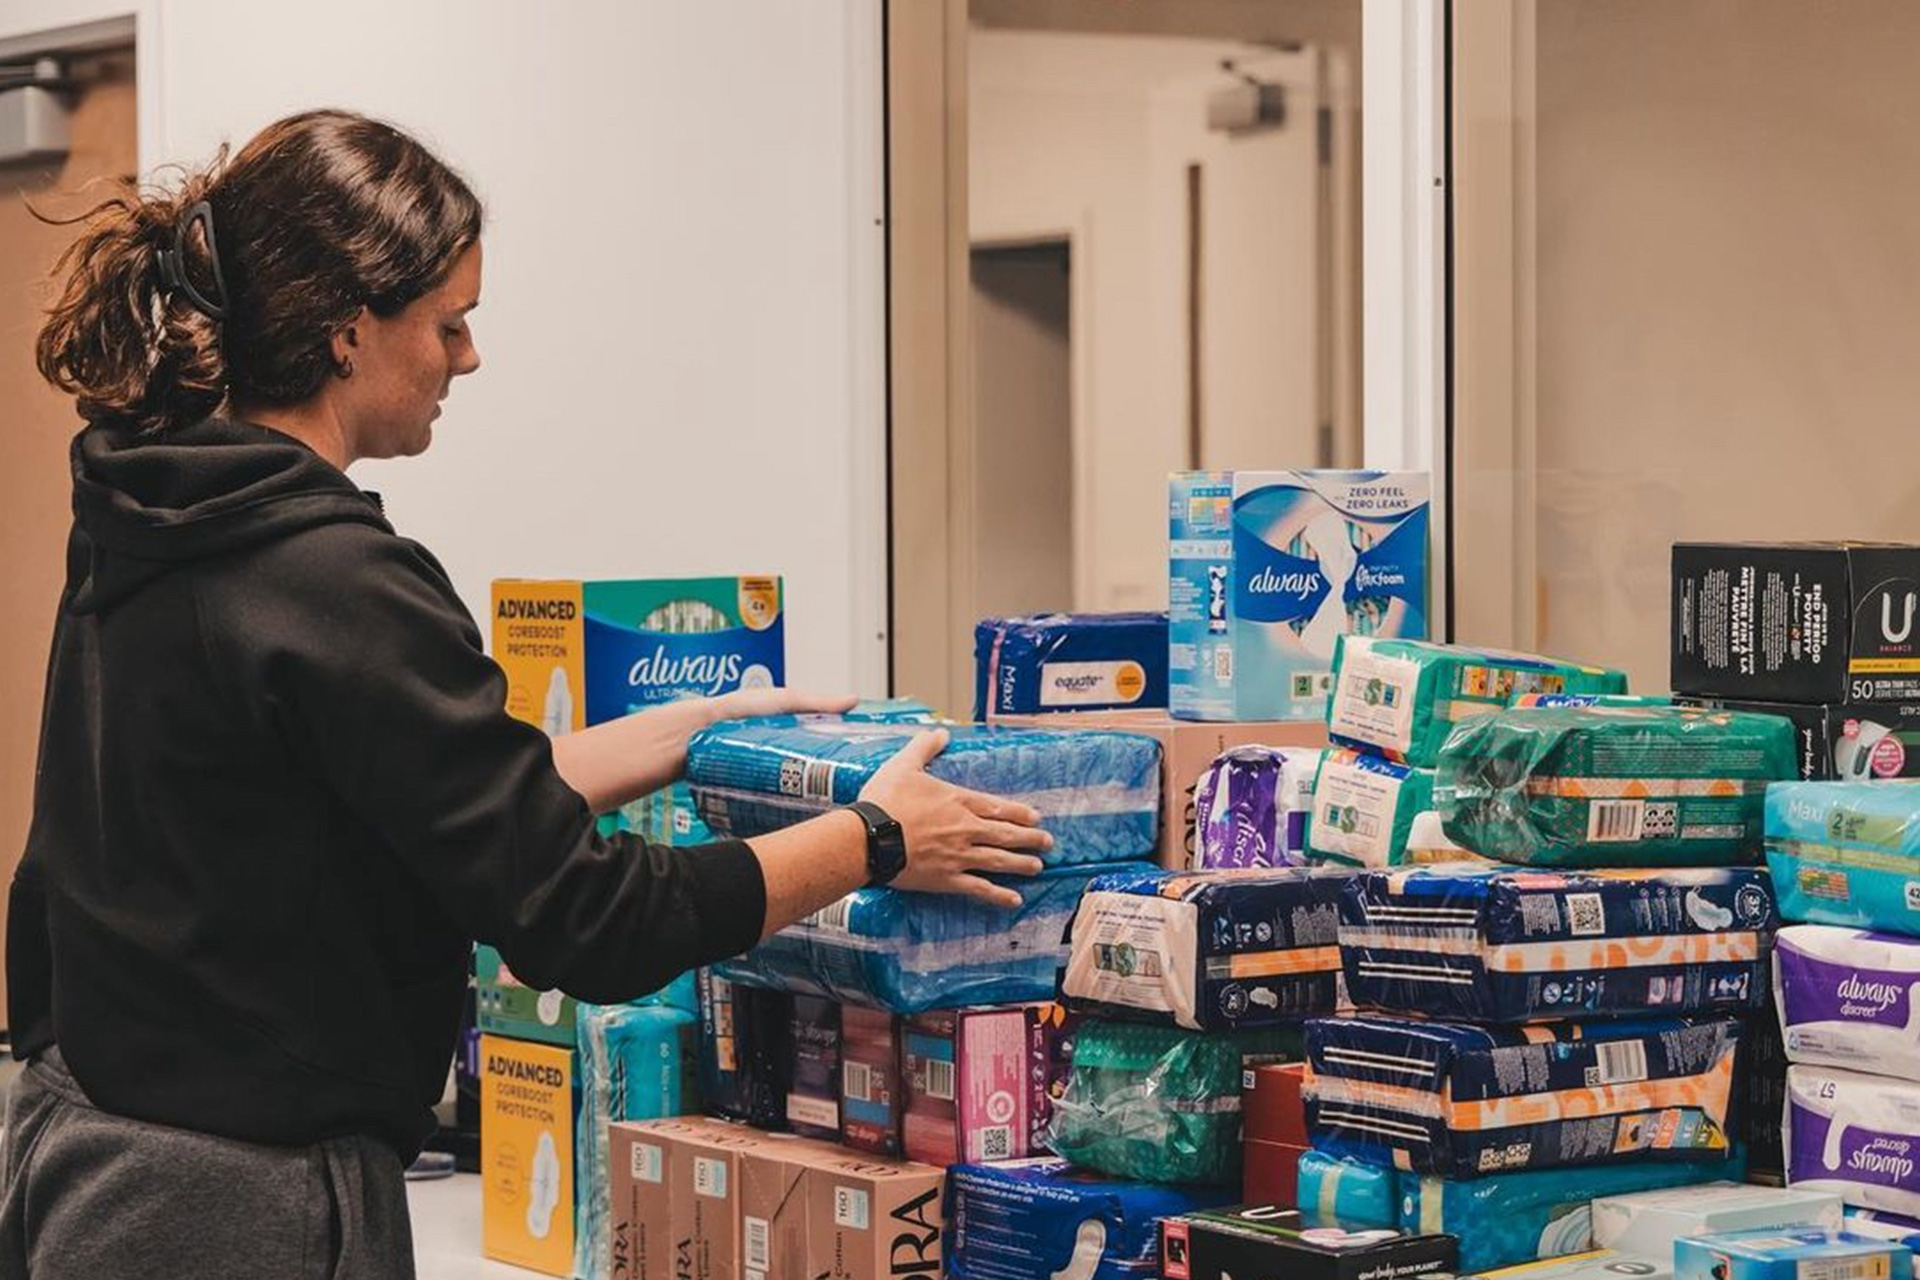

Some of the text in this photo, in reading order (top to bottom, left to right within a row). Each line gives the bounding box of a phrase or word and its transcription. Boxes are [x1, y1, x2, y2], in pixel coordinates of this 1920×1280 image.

[1346, 499, 1409, 509] ZERO LEAKS
[1350, 487, 1404, 497] ZERO FEEL
[1249, 566, 1320, 601] always
[498, 599, 576, 621] ADVANCED
[1731, 586, 1740, 653] PAUVRETÉ
[1740, 567, 1750, 674] METTRE FIN À LA
[1803, 593, 1812, 654] POVERTY
[1812, 583, 1822, 664] END PERIOD
[1881, 592, 1913, 643] U
[508, 626, 566, 640] COREBOOST
[507, 643, 567, 658] PROTECTION
[628, 645, 742, 696] always
[1055, 675, 1099, 689] equate
[1002, 665, 1016, 711] Maxi
[1852, 680, 1873, 699] 50
[1788, 801, 1823, 822] Maxi
[1832, 813, 1844, 830] 2
[1837, 973, 1902, 1011] always
[1840, 1000, 1877, 1017] discreet
[488, 1055, 563, 1088] ADVANCED
[497, 1082, 554, 1104] COREBOOST
[1820, 1082, 1837, 1099] 57
[496, 1099, 555, 1123] PROTECTION
[1847, 1144, 1913, 1183] always
[838, 1191, 848, 1218] 160
[889, 1187, 941, 1280] RA
[677, 1239, 691, 1280] RA
[836, 1231, 844, 1277] Cotton
[1397, 1265, 1414, 1276] YOUR
